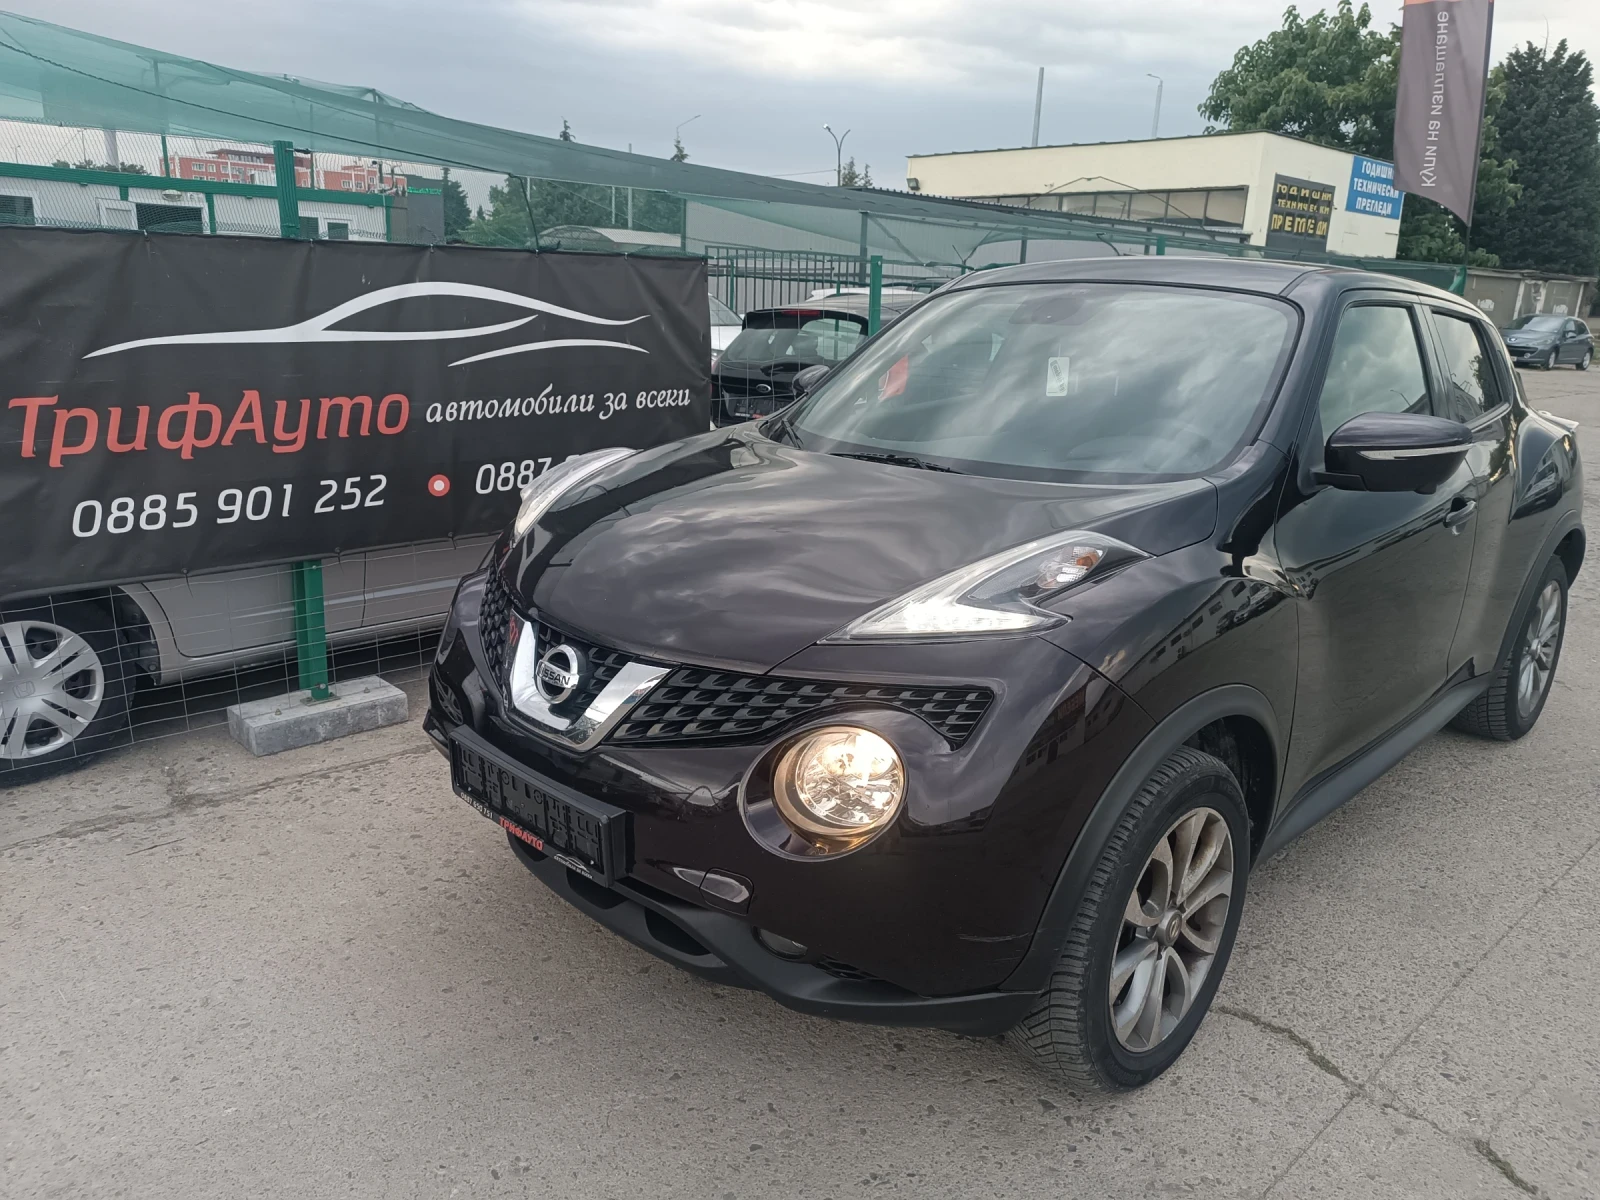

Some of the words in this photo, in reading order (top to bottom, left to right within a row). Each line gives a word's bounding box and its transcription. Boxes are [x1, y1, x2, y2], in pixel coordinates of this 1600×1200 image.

[1361, 160, 1394, 180] ГОДИШН
[1355, 197, 1393, 216] ПРЕГЛЕДИ
[425, 382, 595, 424] автомобили
[598, 393, 629, 420] за
[635, 387, 691, 410] всеки
[8, 389, 409, 468] ТрифАуто
[71, 491, 199, 538] 0885
[216, 484, 291, 524] 901
[313, 474, 389, 514] 252
[499, 815, 544, 851] ТРИФАУТО
